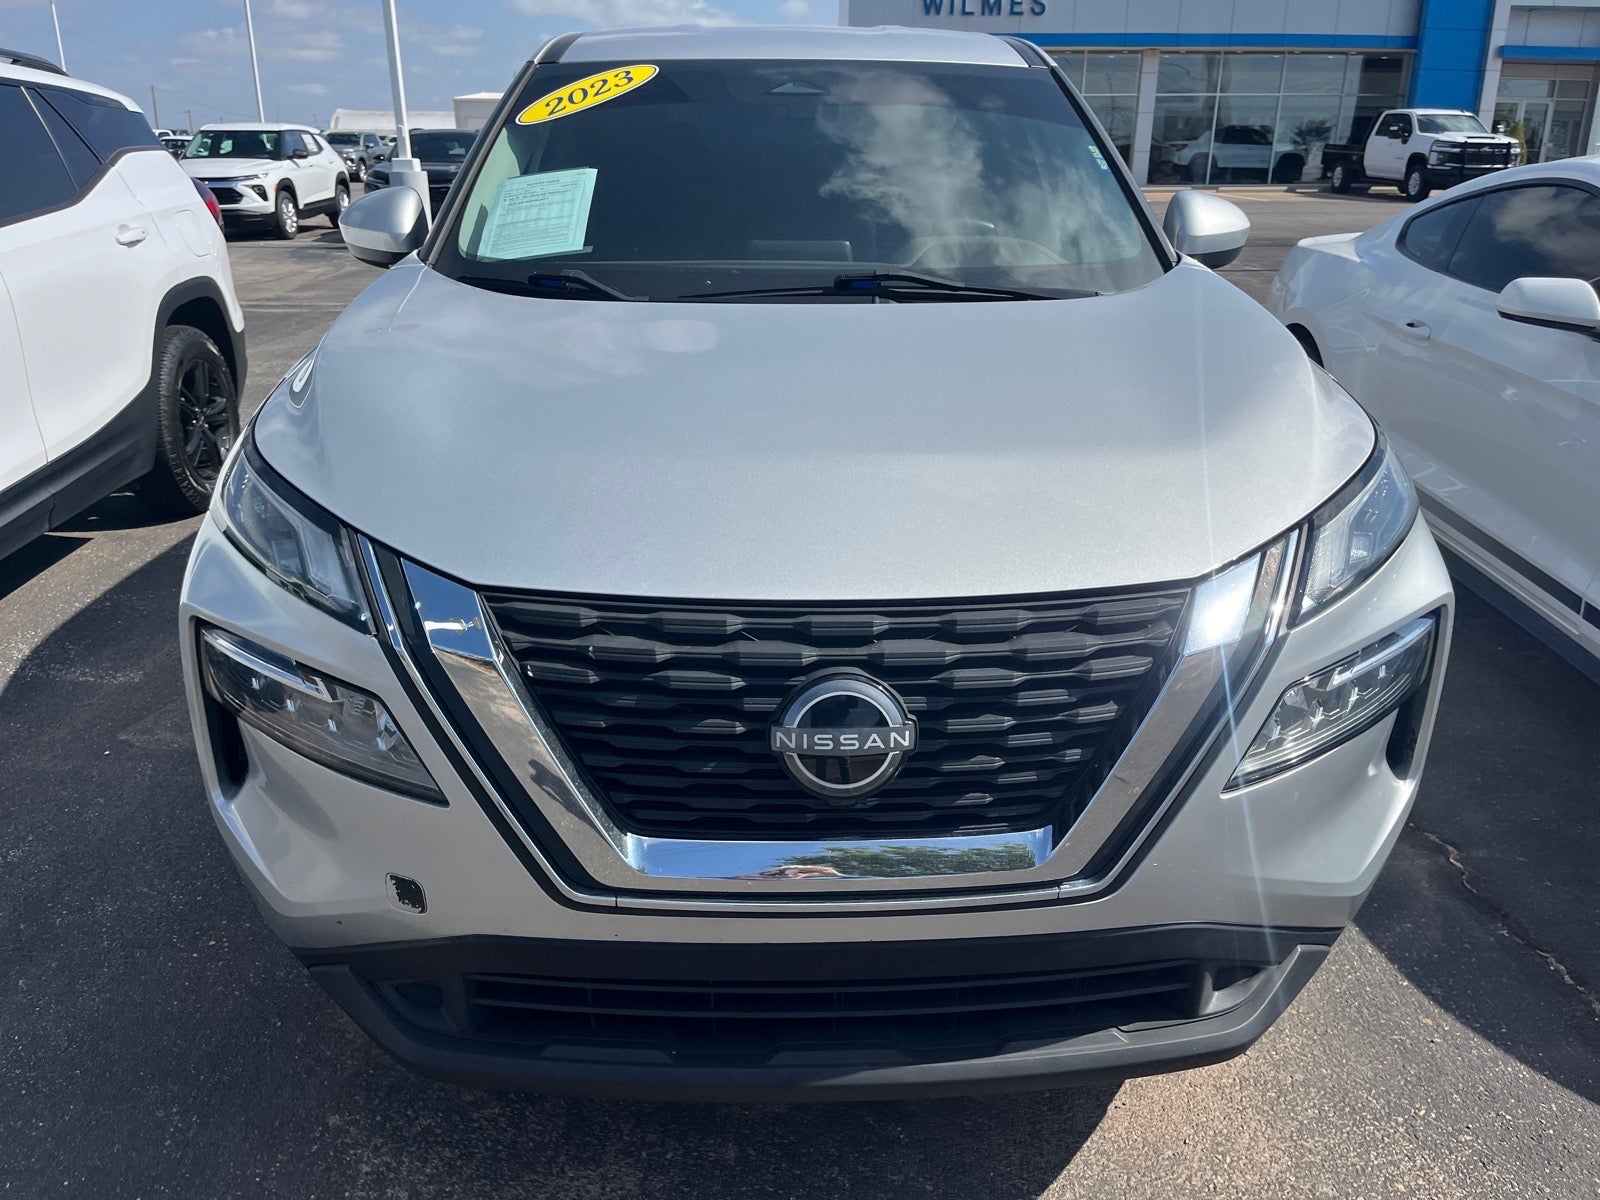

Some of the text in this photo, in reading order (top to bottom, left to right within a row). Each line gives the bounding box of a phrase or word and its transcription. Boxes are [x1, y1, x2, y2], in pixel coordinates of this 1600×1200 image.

[922, 0, 1047, 17] WILMES
[544, 69, 634, 117] 2023
[775, 730, 911, 750] NISSAN
